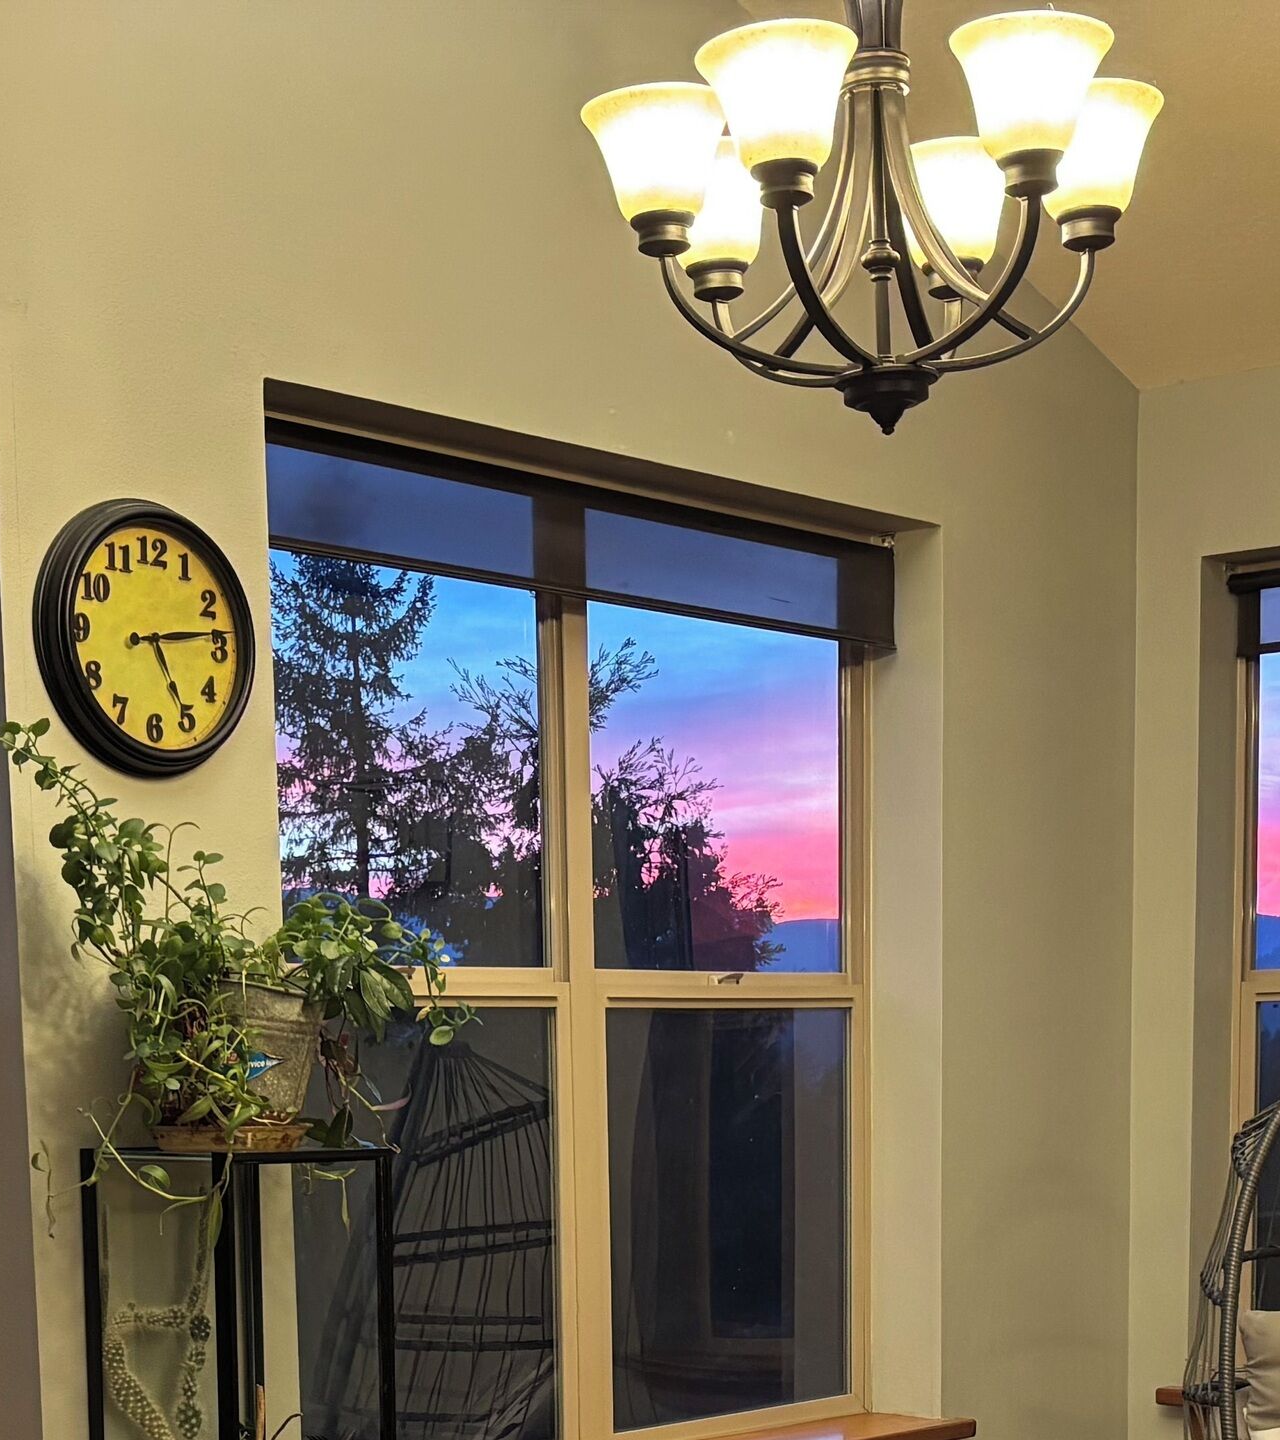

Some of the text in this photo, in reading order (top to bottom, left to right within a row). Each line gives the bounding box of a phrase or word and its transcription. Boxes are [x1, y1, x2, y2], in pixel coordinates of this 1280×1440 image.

[104, 542, 134, 573] 11
[136, 535, 168, 570] 12
[178, 553, 192, 581] 1
[81, 571, 111, 602] 10
[199, 589, 217, 620] 2
[74, 612, 91, 643] 9
[211, 629, 228, 664] 3
[85, 660, 102, 690] 8
[201, 675, 217, 703] 4
[112, 693, 129, 726] 7
[178, 703, 196, 733] 5
[146, 713, 164, 743] 6
